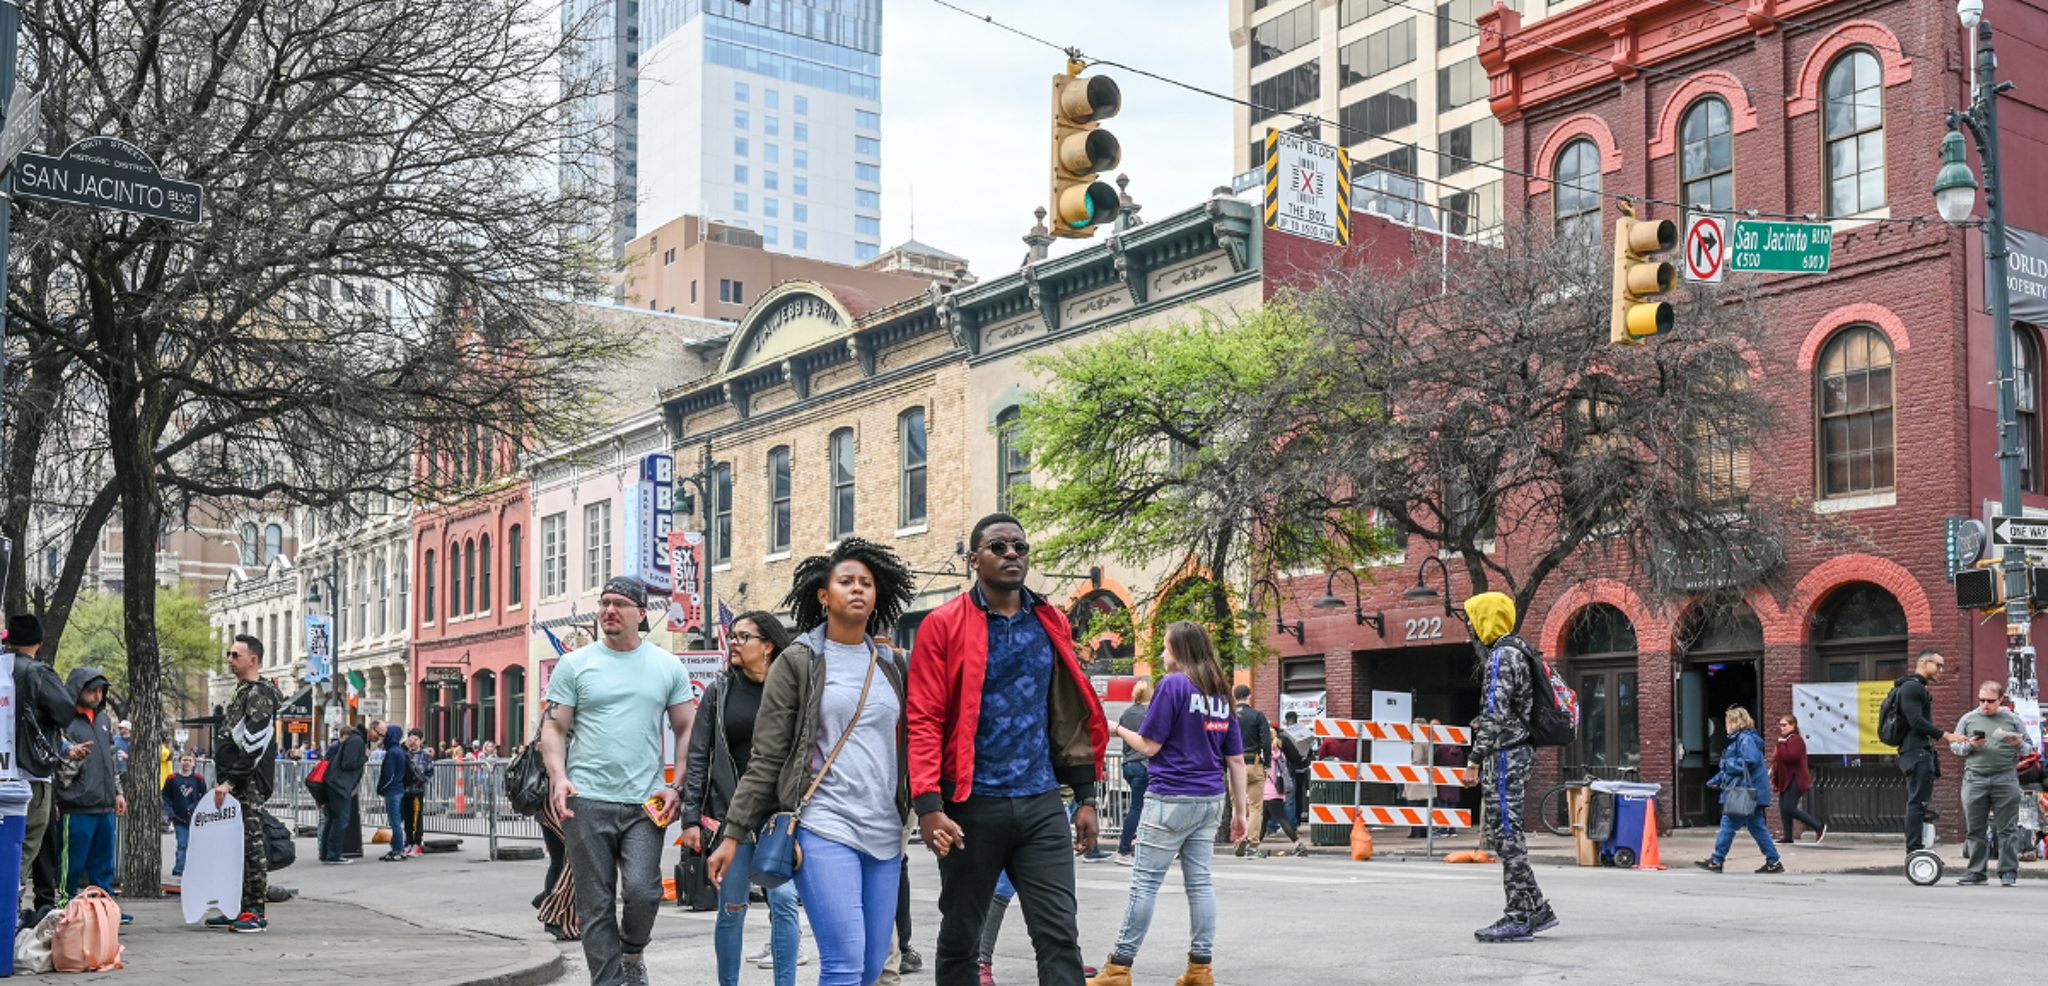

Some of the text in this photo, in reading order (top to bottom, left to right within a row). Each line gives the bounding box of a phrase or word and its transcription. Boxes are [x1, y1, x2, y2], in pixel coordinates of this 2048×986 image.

[110, 141, 146, 162] STREET
[1307, 141, 1335, 160] BLOCK
[69, 153, 153, 174] HISTORIC DISTRICT
[21, 163, 197, 209] SAN JACINTO BLVD
[1288, 202, 1327, 224] THE BOX
[1291, 220, 1299, 231] TO
[1320, 227, 1334, 241] FINE
[1735, 224, 1830, 252] San Jacinto BLVD
[2007, 248, 2047, 279] ORLD
[2010, 525, 2047, 537] ONE WAY
[650, 573, 672, 585] SPOR
[1405, 616, 1443, 641] 222
[701, 656, 721, 665] POINT
